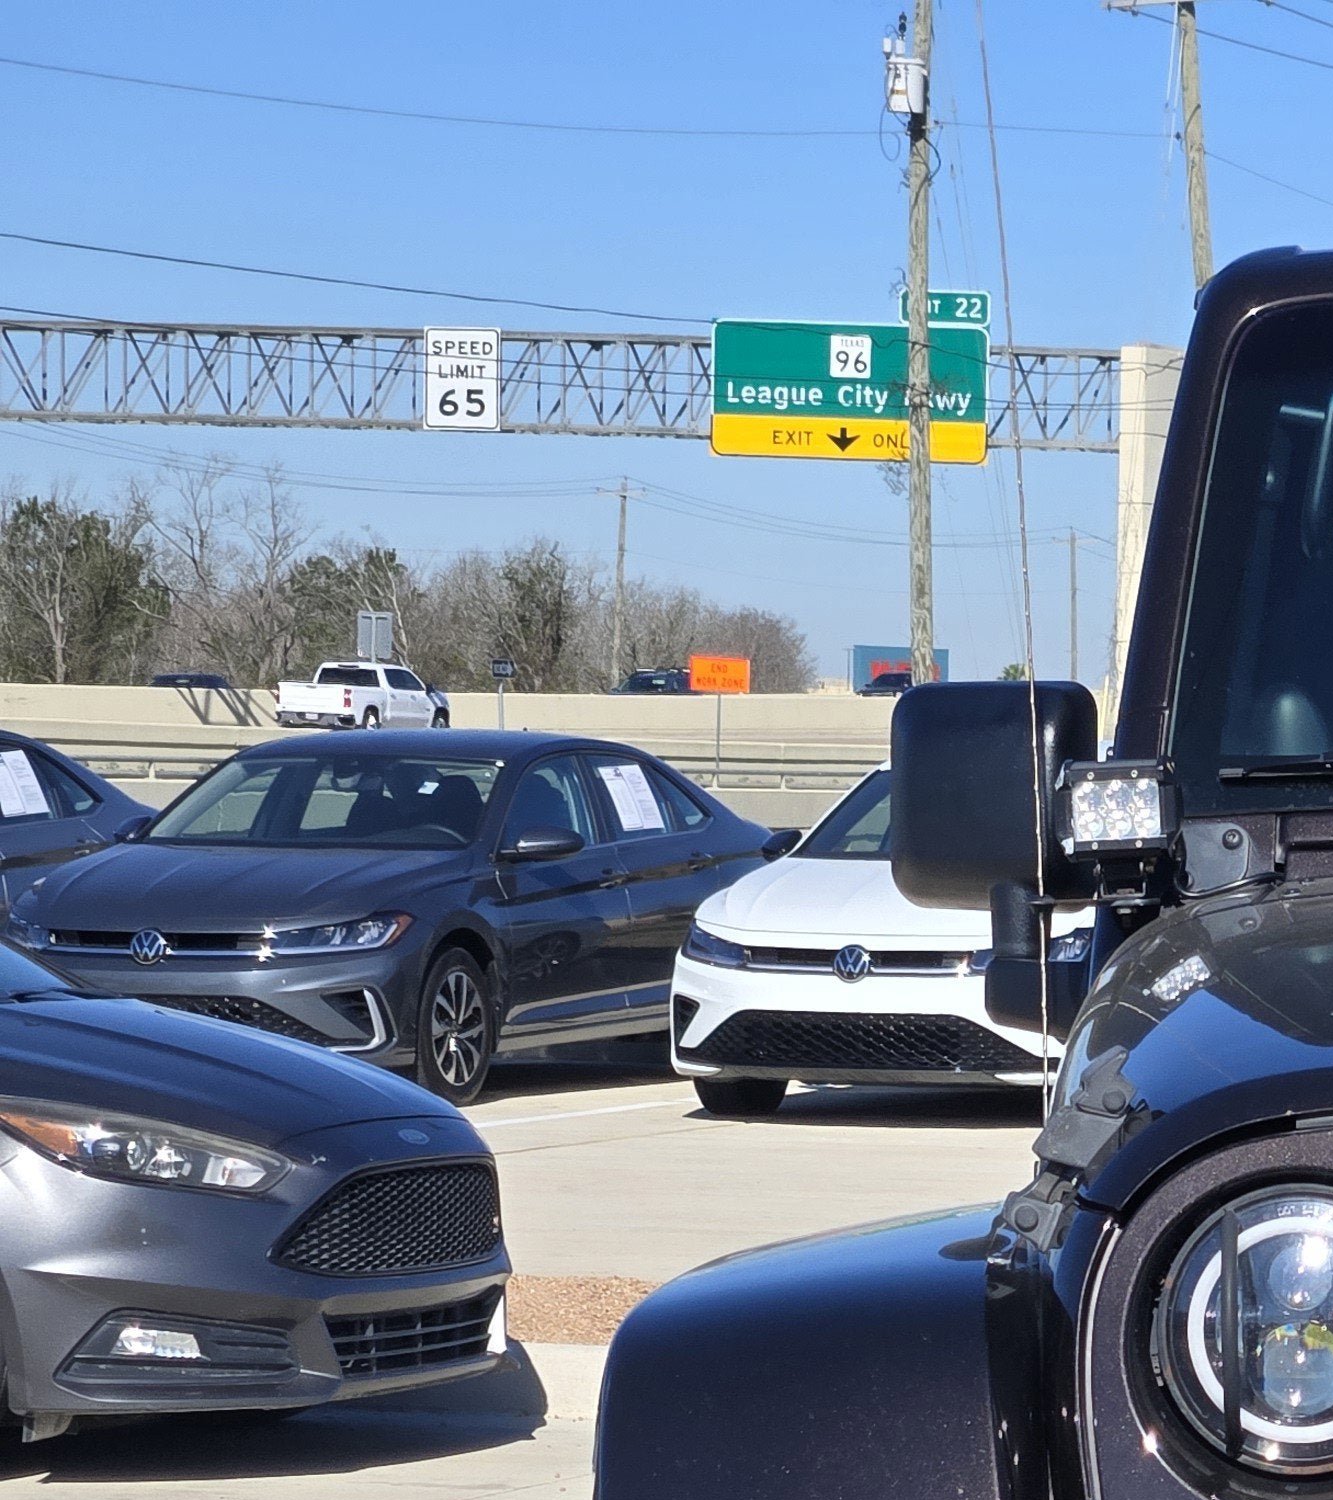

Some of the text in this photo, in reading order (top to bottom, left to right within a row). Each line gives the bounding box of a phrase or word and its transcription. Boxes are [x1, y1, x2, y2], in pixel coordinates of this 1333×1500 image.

[955, 297, 983, 319] 22
[432, 340, 494, 356] SPEED
[438, 363, 487, 379] LIMIT
[835, 350, 868, 374] 96
[439, 388, 486, 418] 65
[727, 381, 972, 416] League City wy
[772, 429, 911, 451] EXIT ONL
[710, 662, 728, 674] END
[720, 676, 745, 689] ZONE
